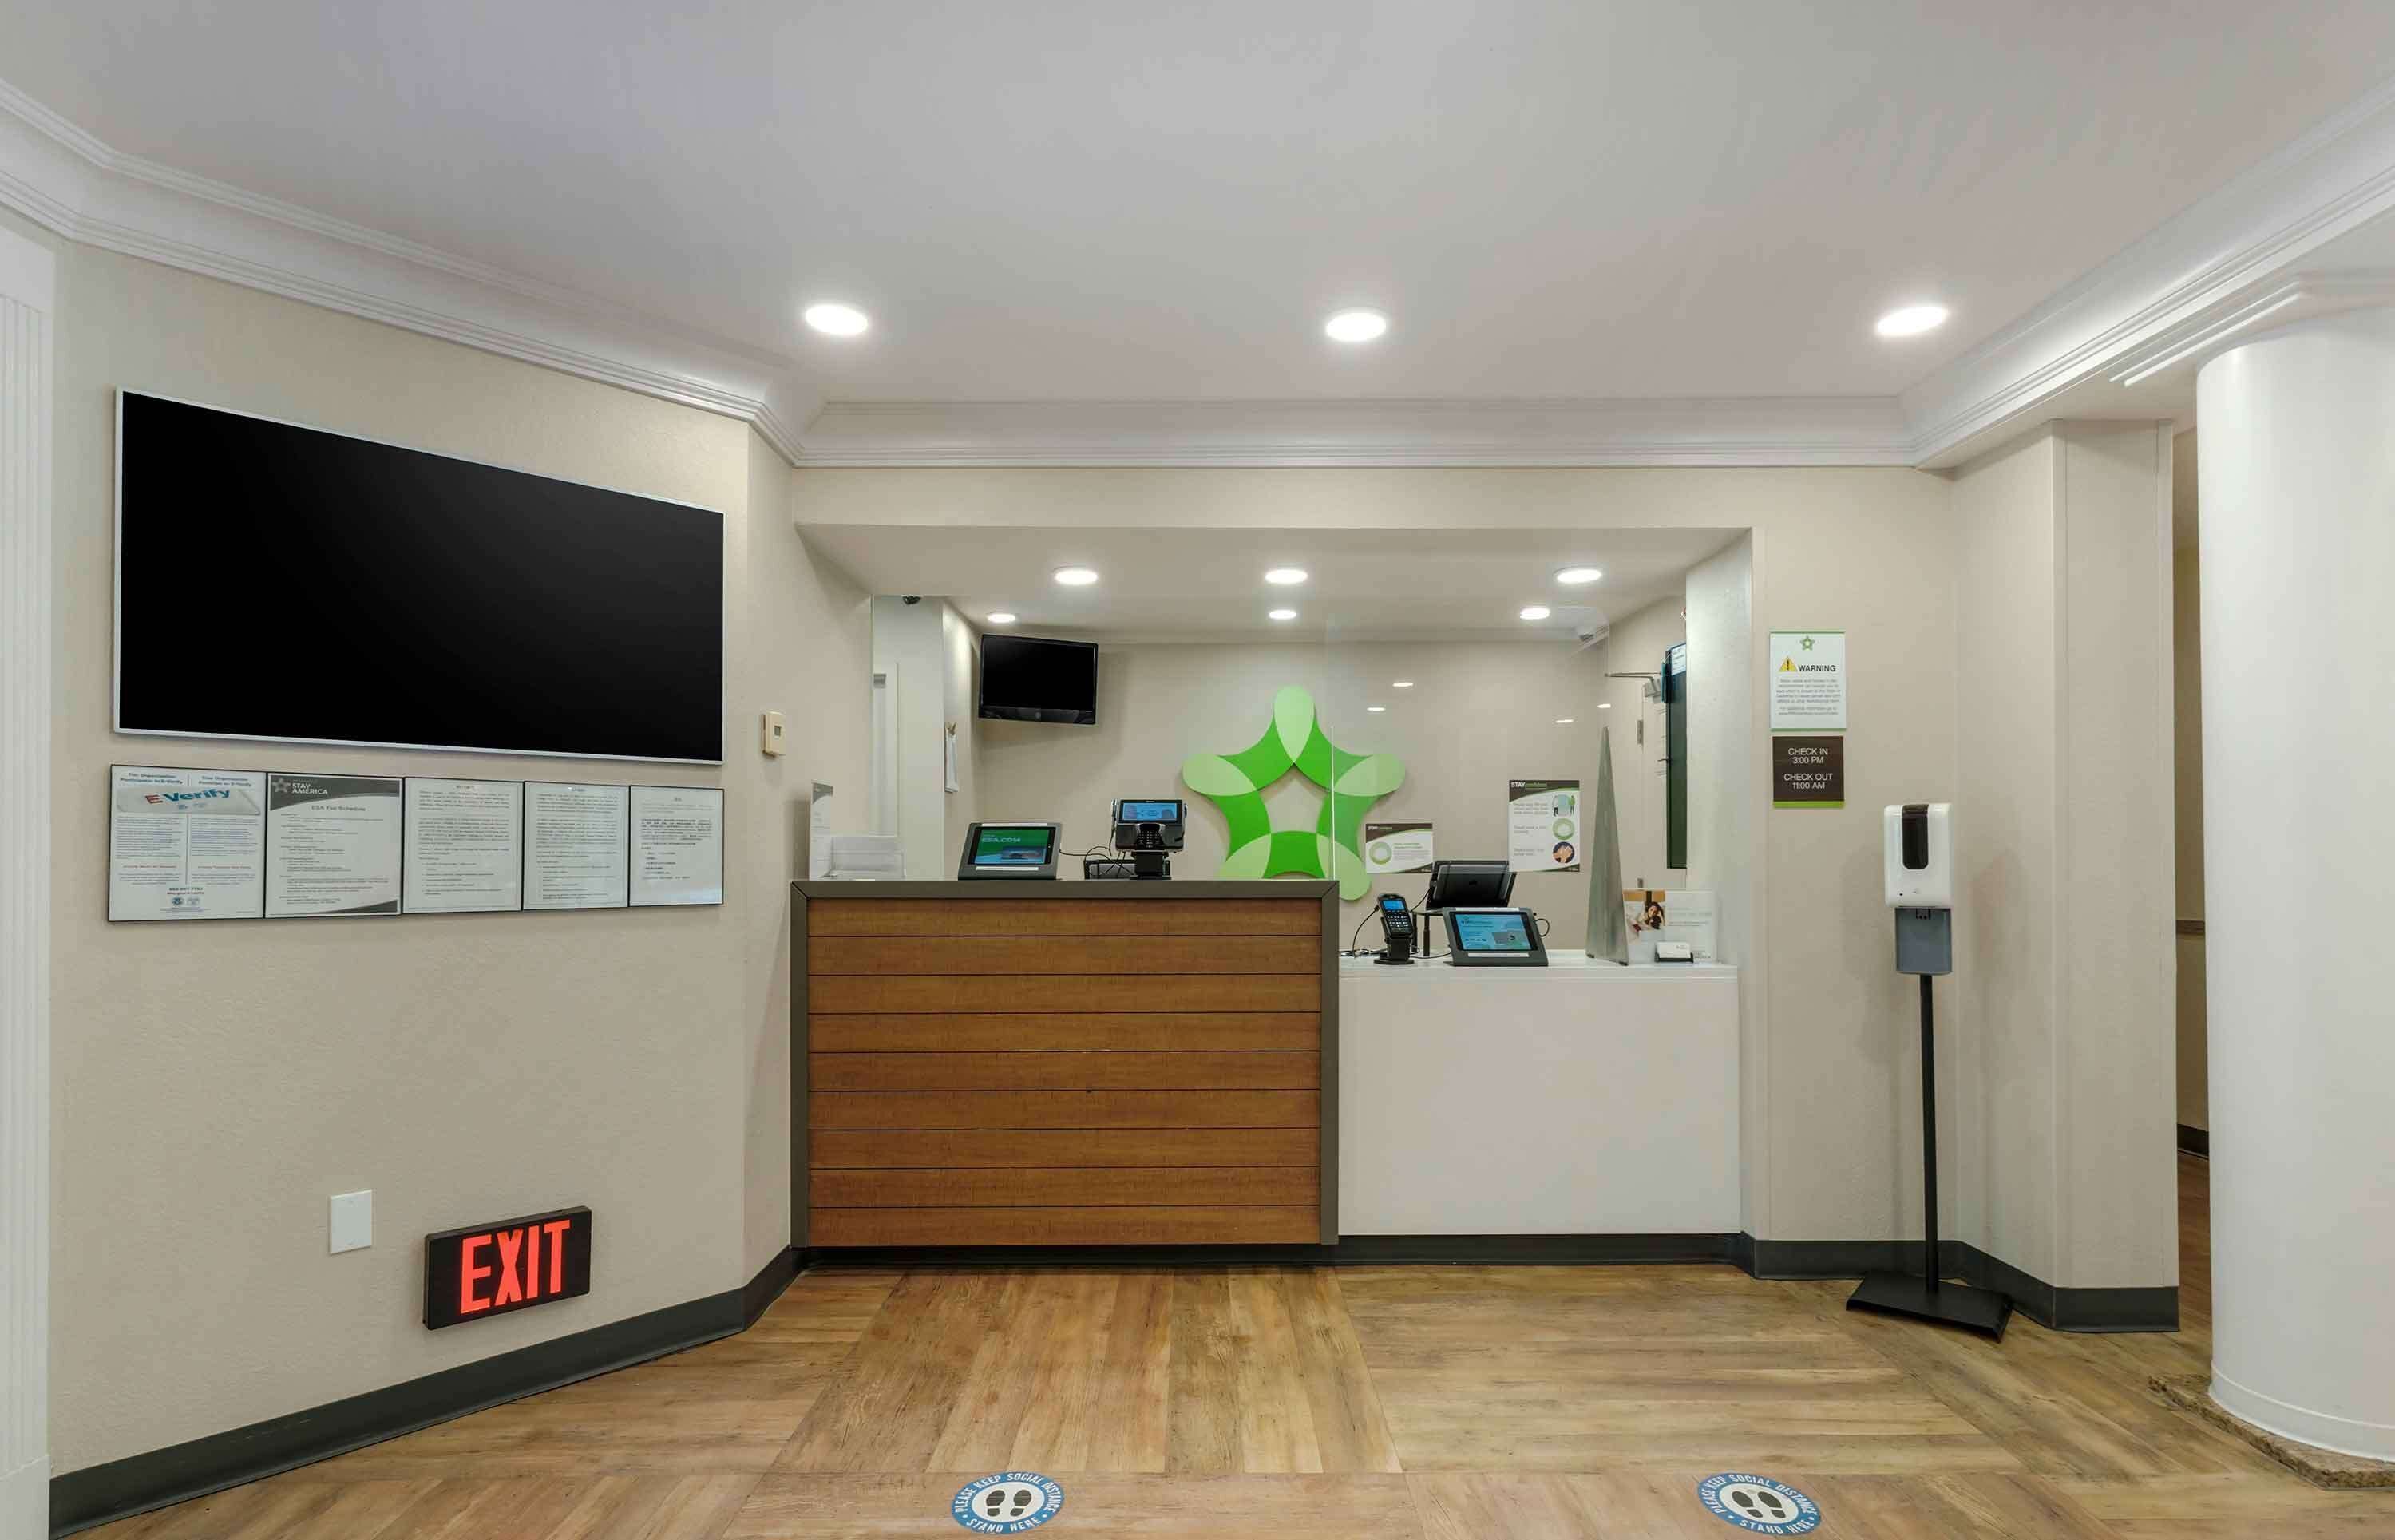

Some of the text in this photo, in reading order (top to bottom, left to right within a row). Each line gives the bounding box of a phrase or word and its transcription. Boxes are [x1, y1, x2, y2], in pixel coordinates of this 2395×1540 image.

[1788, 747, 1828, 756] CHECK IN
[461, 1220, 570, 1314] EXIT
[955, 1472, 1062, 1513] PLEASE KEEP SOCIAL DISTANCE
[1704, 1475, 1727, 1490] KEEP
[1728, 1475, 1771, 1487] SOCIAL
[1775, 1483, 1818, 1516] DISTANCE
[966, 1516, 1042, 1533] STAND HERE
[1739, 1519, 1815, 1534] STAND HERE
